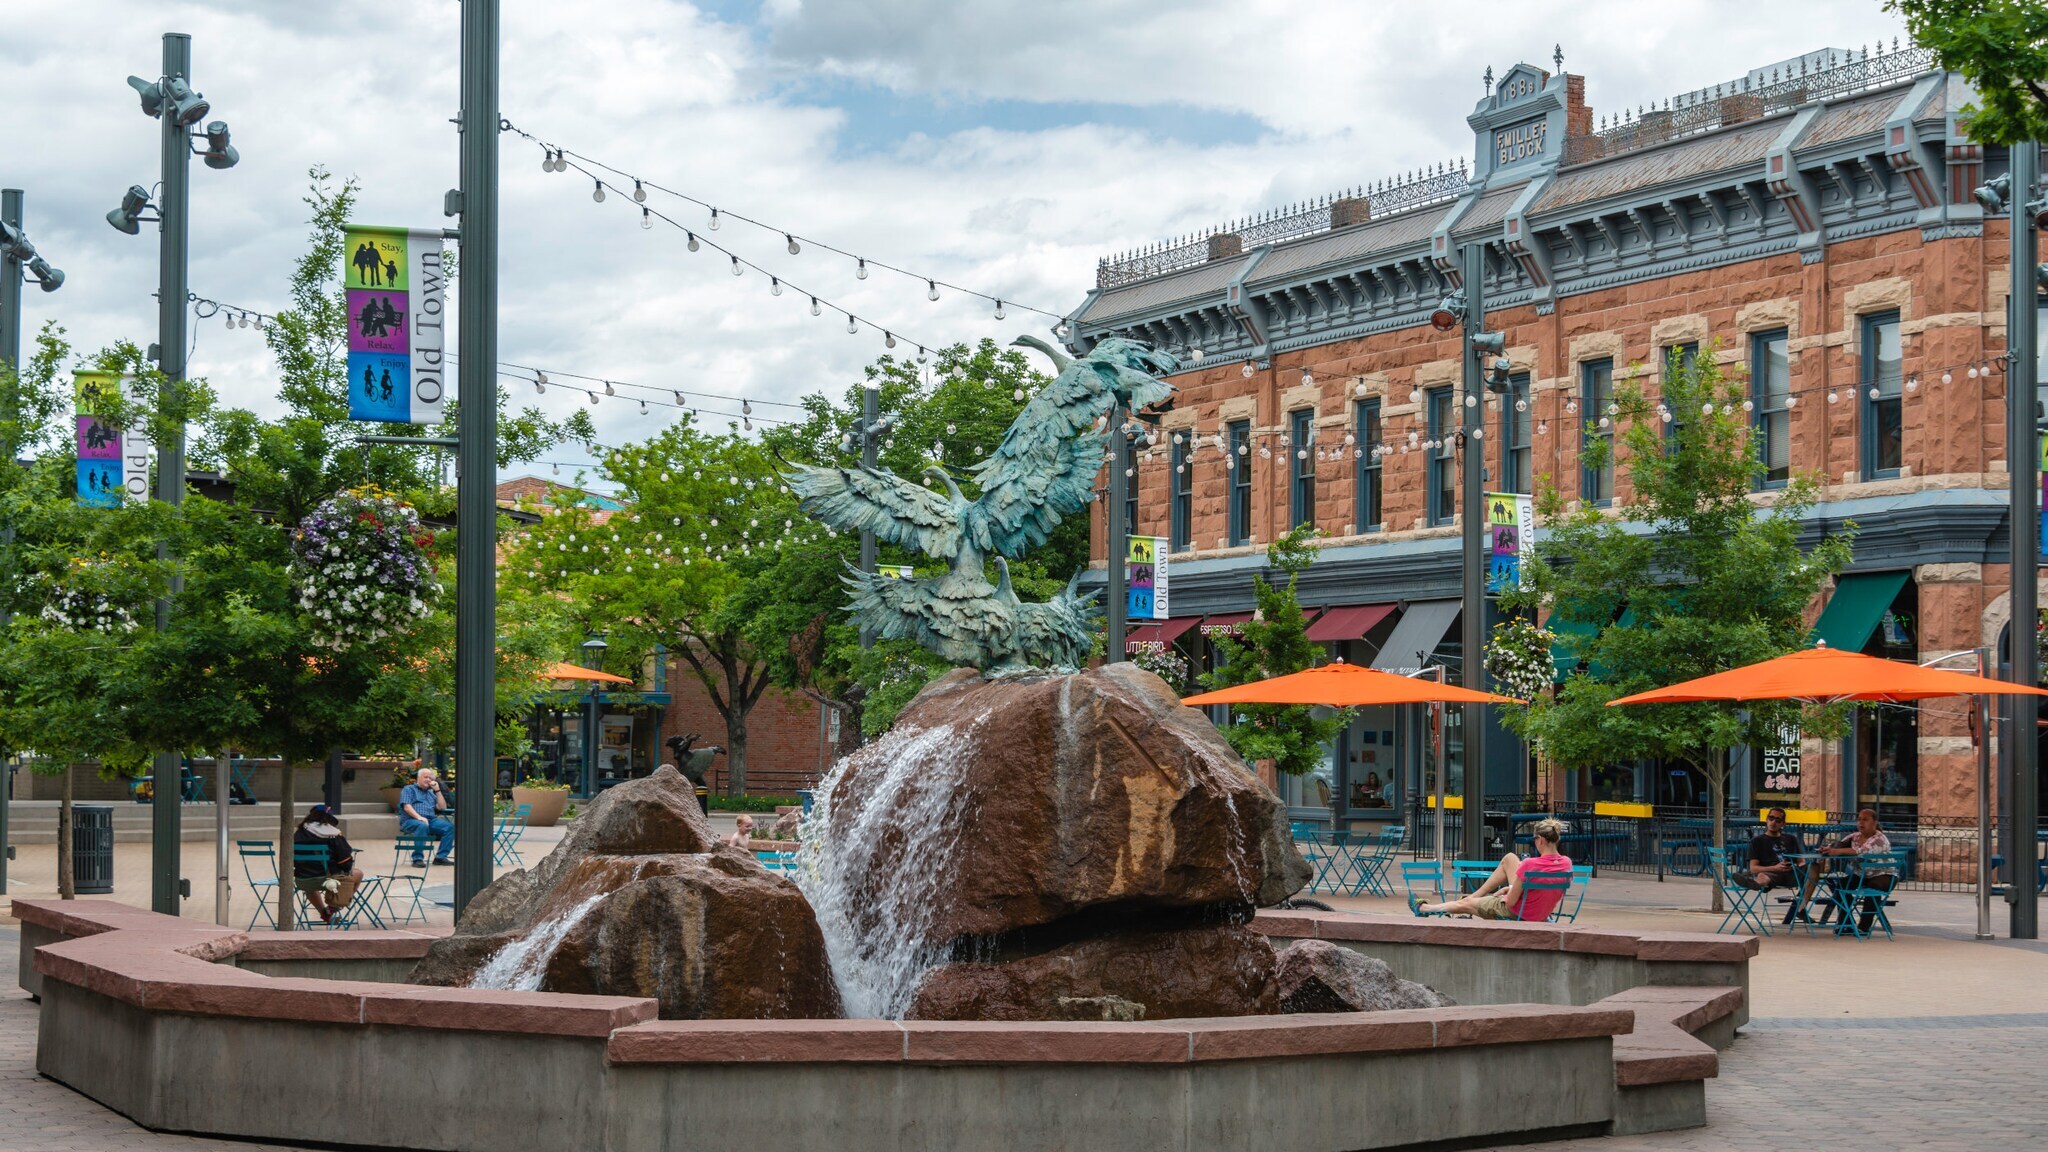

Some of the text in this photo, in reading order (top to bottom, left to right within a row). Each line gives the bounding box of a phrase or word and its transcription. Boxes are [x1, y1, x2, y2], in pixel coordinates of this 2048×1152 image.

[1500, 138, 1544, 164] BLOCK
[381, 242, 404, 254] Stay,
[415, 250, 442, 404] Old Town
[367, 340, 395, 350] Relax,
[126, 387, 147, 495] Old Ton
[1520, 505, 1533, 548] Town
[1155, 546, 1168, 611] Old Town
[1764, 758, 1800, 773] BAR
[1775, 773, 1800, 790] Grill
